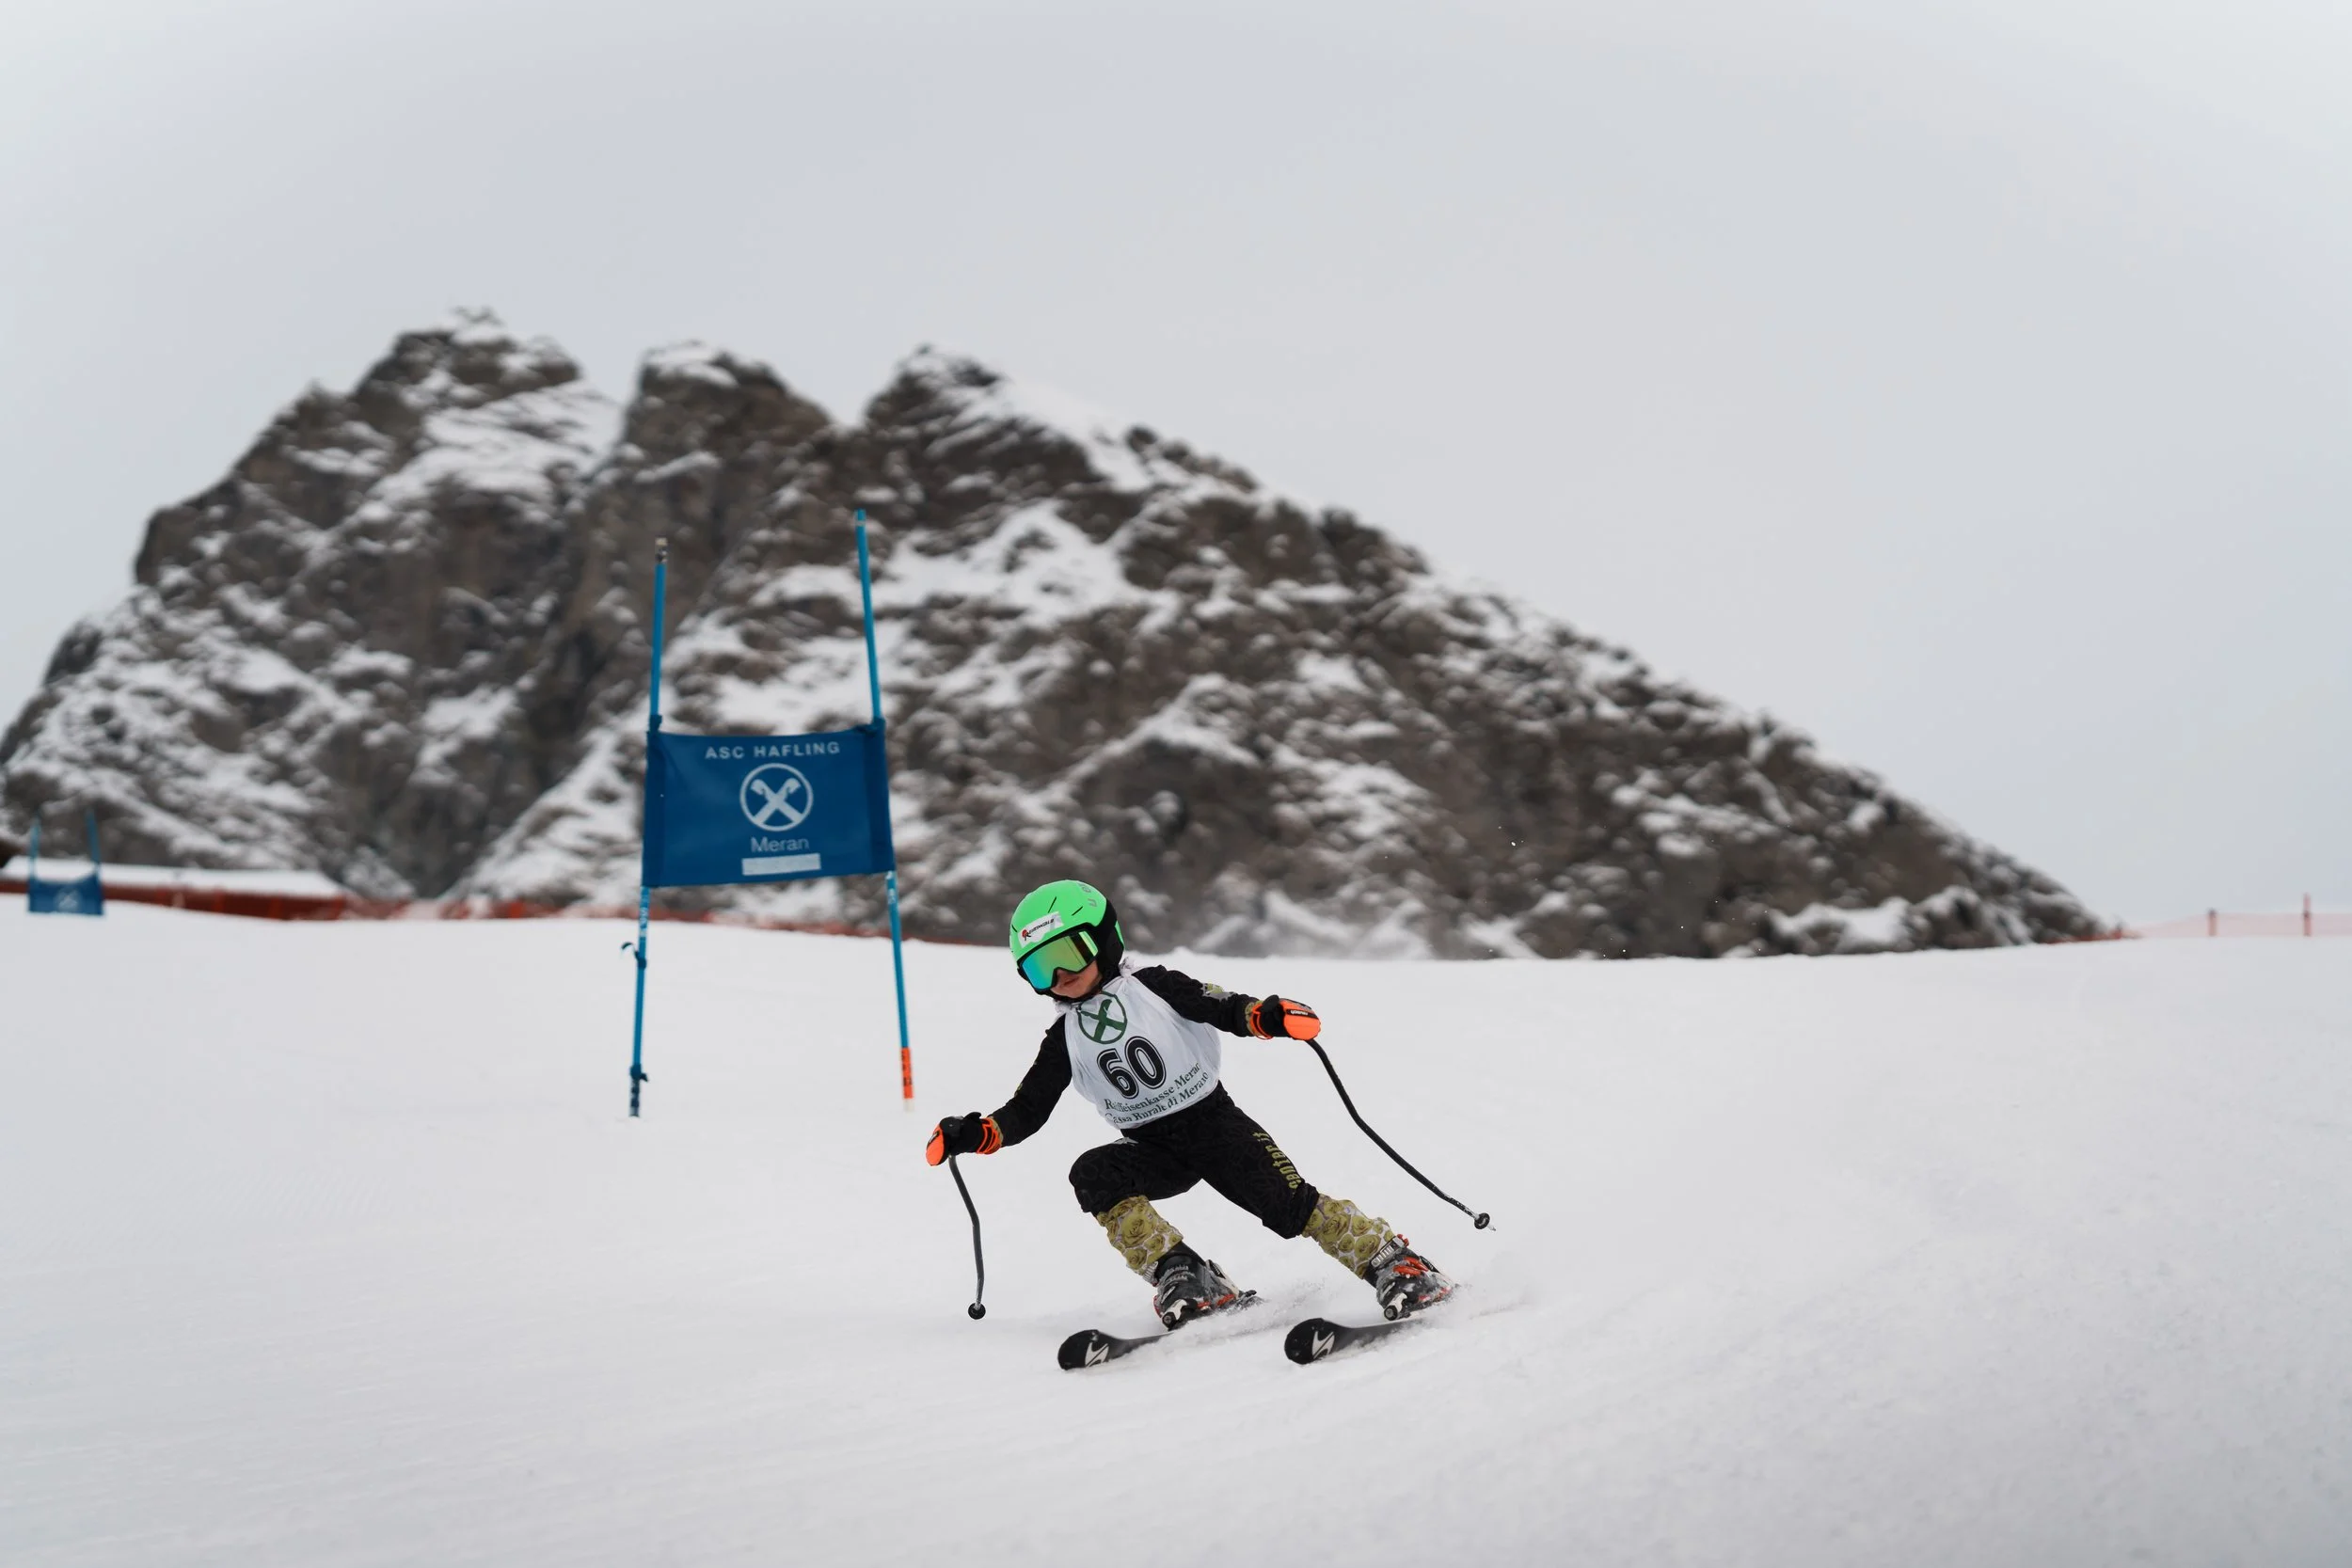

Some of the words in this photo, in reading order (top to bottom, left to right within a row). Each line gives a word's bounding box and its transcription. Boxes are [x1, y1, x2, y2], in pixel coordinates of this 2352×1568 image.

[705, 746, 744, 759] ASC
[754, 741, 840, 757] HAFLING
[751, 836, 810, 852] Meran
[1097, 1036, 1167, 1100] 60
[1168, 1096, 1178, 1109] di
